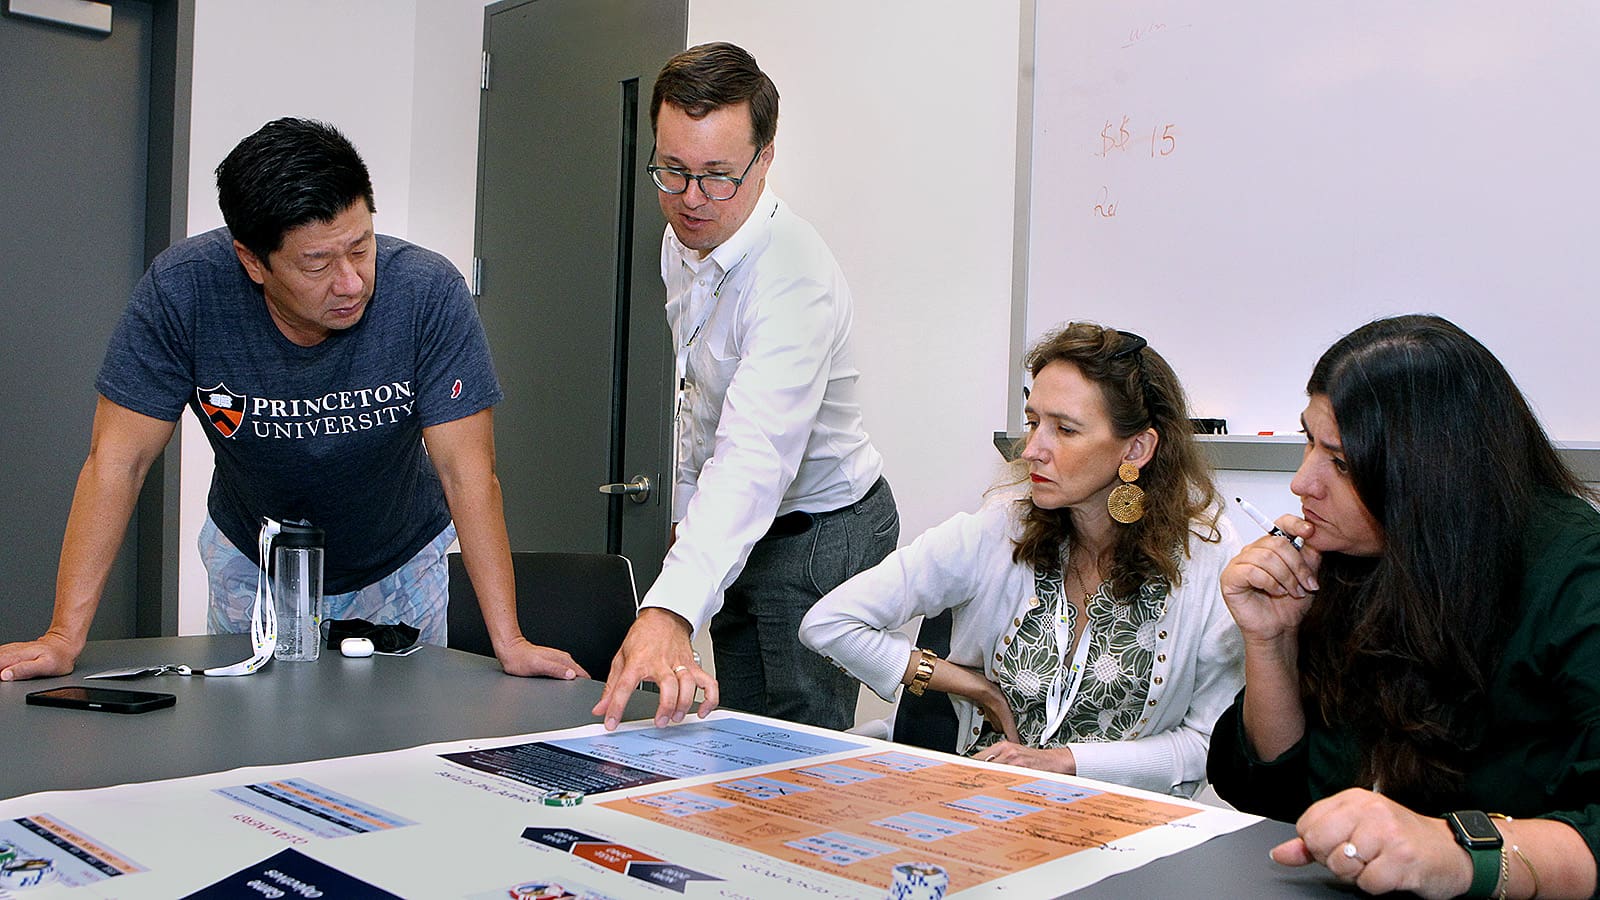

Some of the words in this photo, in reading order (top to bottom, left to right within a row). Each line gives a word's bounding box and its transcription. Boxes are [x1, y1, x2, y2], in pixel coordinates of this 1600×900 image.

[1151, 124, 1177, 158] 15
[251, 381, 413, 417] PRINCETON
[252, 400, 416, 439] UNIVERSITY
[232, 814, 276, 831] ENERGY
[270, 829, 309, 844] CLEAN
[246, 879, 286, 899] Game
[263, 869, 324, 899] Objectives
